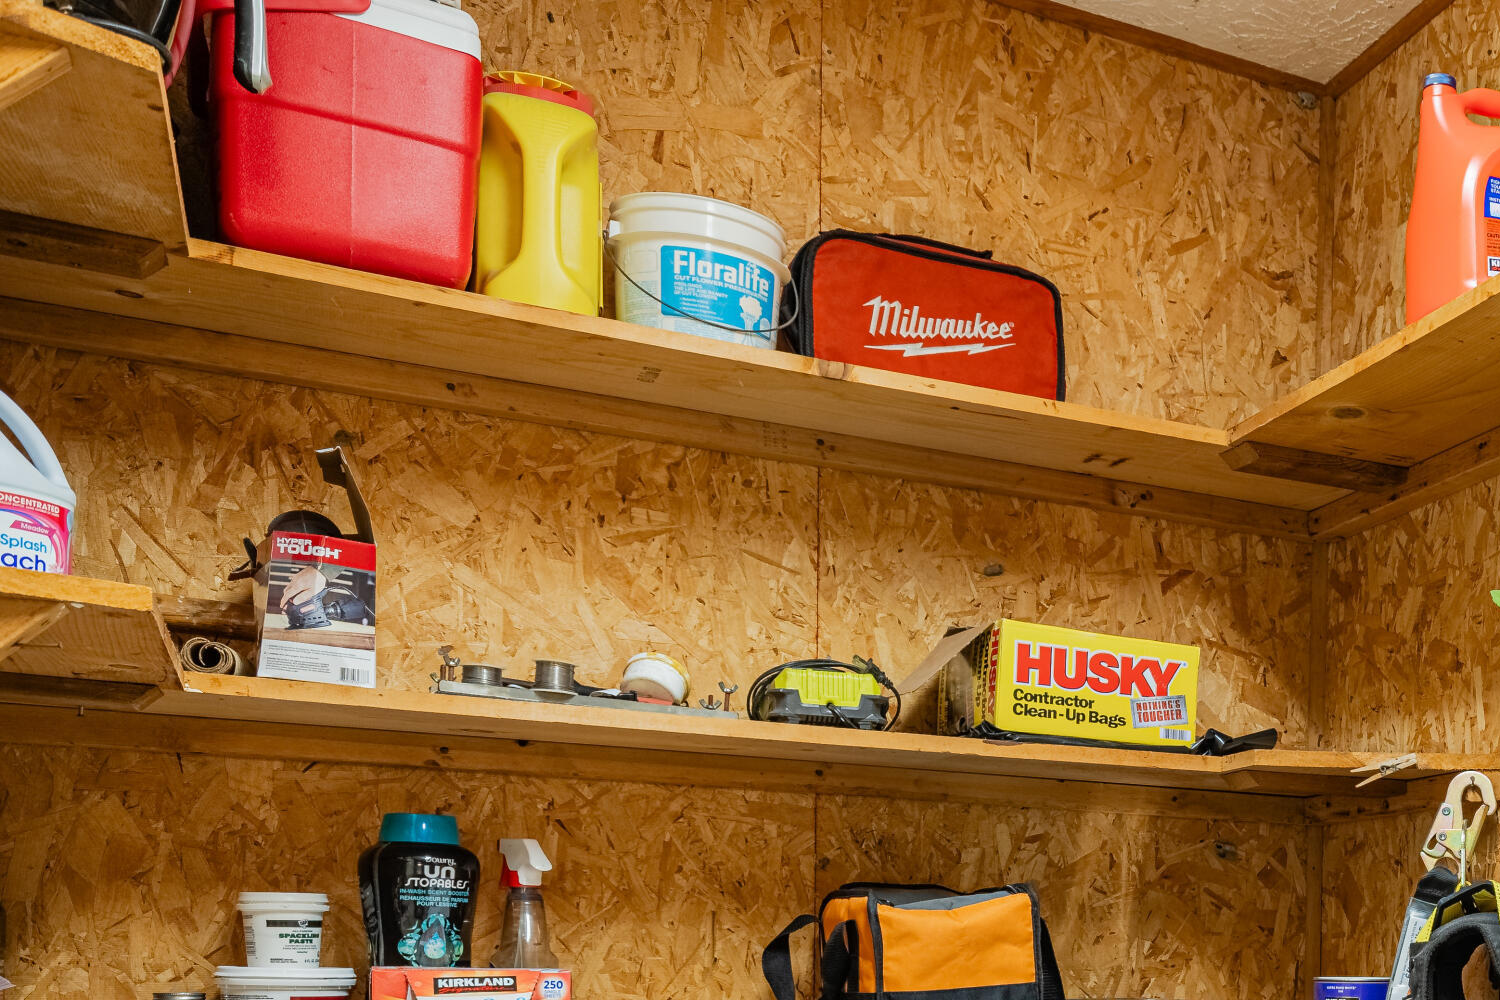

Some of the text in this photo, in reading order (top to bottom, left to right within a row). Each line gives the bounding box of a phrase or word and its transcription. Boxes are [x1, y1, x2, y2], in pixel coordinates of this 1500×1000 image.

[673, 249, 769, 298] Floralife
[862, 295, 1013, 339] Milwaukee
[20, 523, 50, 534] Meadow
[0, 533, 47, 553] Splash
[276, 537, 312, 546] HYPER
[277, 543, 339, 560] TOUGH
[1014, 641, 1182, 698] HUSKY
[1013, 689, 1095, 710] Contractor
[1136, 699, 1181, 712] NOTHING'S
[1088, 713, 1127, 729] Bags
[1137, 711, 1184, 723] TOUGHER
[425, 857, 456, 866] Downy
[404, 878, 469, 889] STOPABLES
[437, 977, 515, 987] KIRKLAND
[543, 980, 563, 989] 250
